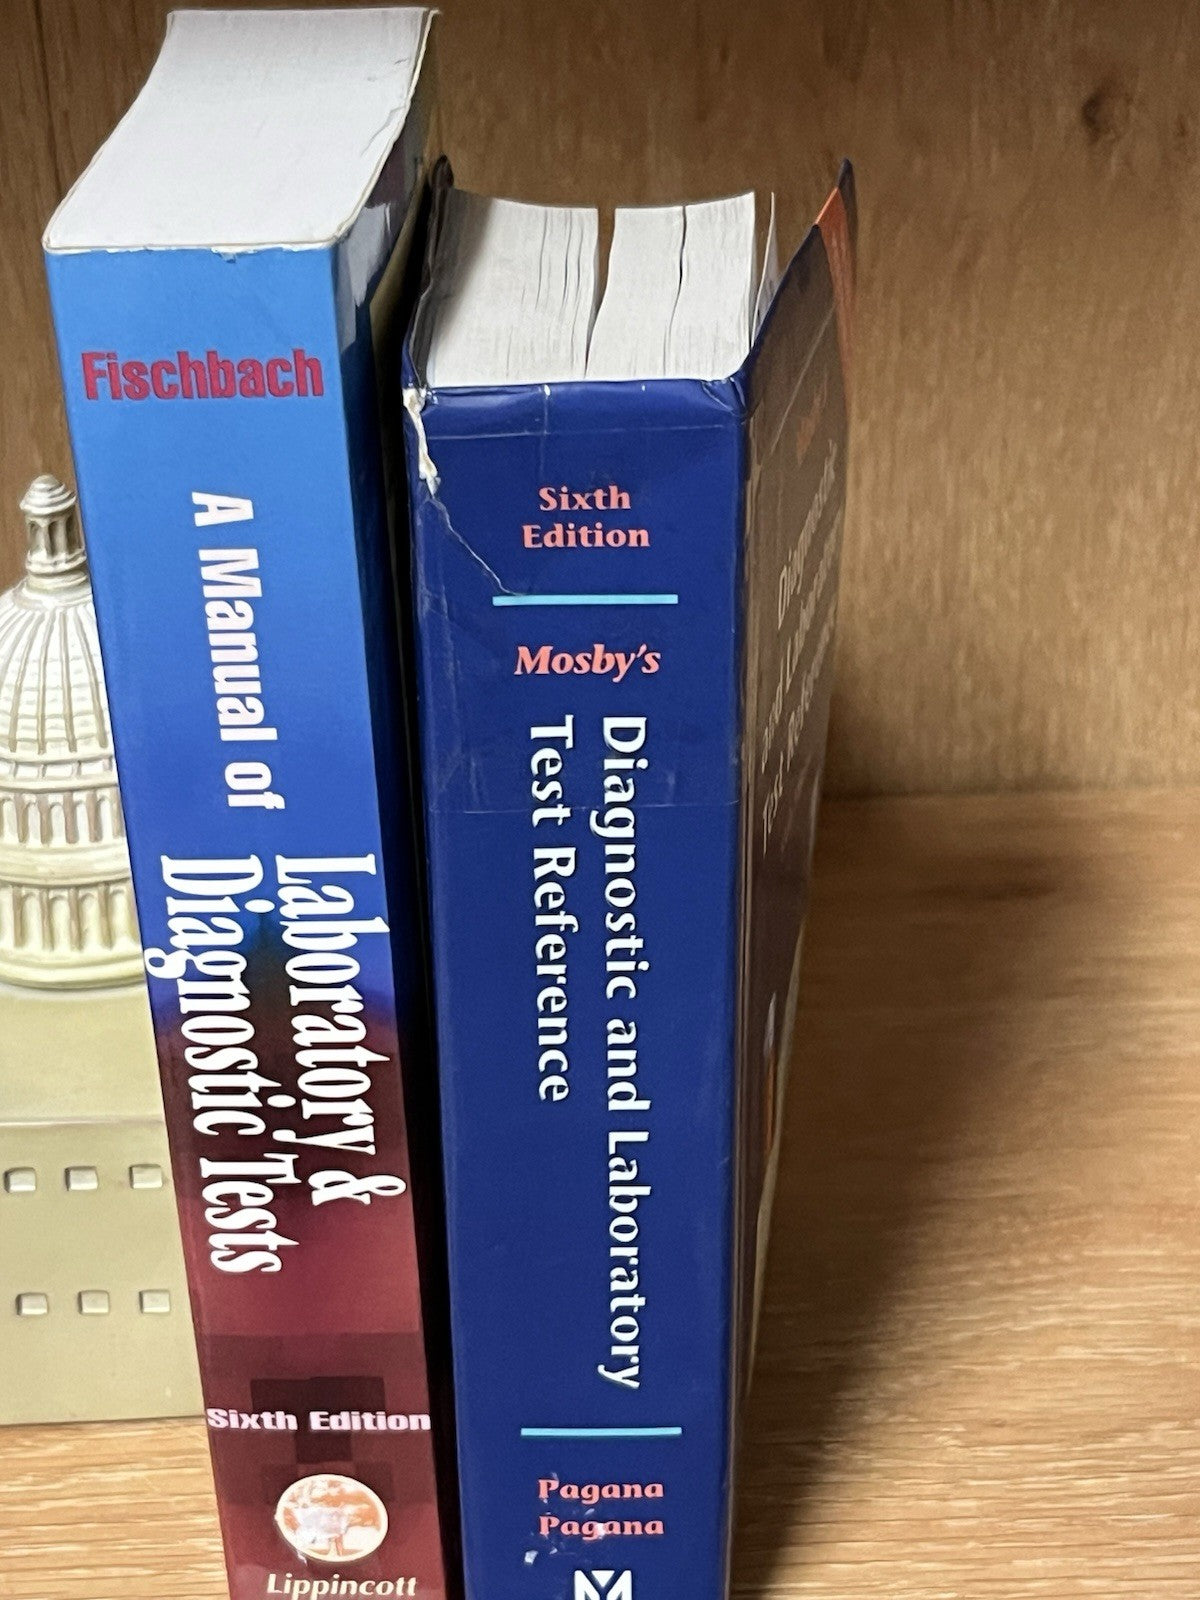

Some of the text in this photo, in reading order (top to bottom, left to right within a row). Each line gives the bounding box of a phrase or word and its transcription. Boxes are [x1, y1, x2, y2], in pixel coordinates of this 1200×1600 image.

[81, 348, 323, 399] Fischbach
[539, 485, 631, 511] Sixth
[522, 522, 650, 549] Edition
[191, 491, 286, 810] A Manual of
[514, 643, 661, 683] Mosby's
[530, 714, 579, 1102] Test Reference
[274, 854, 406, 1206] Laboratory &
[144, 854, 302, 1273] Diagnostic Tests
[589, 716, 652, 1388] Diagnostic and Laboratory
[206, 1408, 431, 1432] Sixth Edition
[538, 1479, 664, 1505] Pagana
[538, 1516, 664, 1541] Pagana
[266, 1572, 417, 1600] Lippincott
